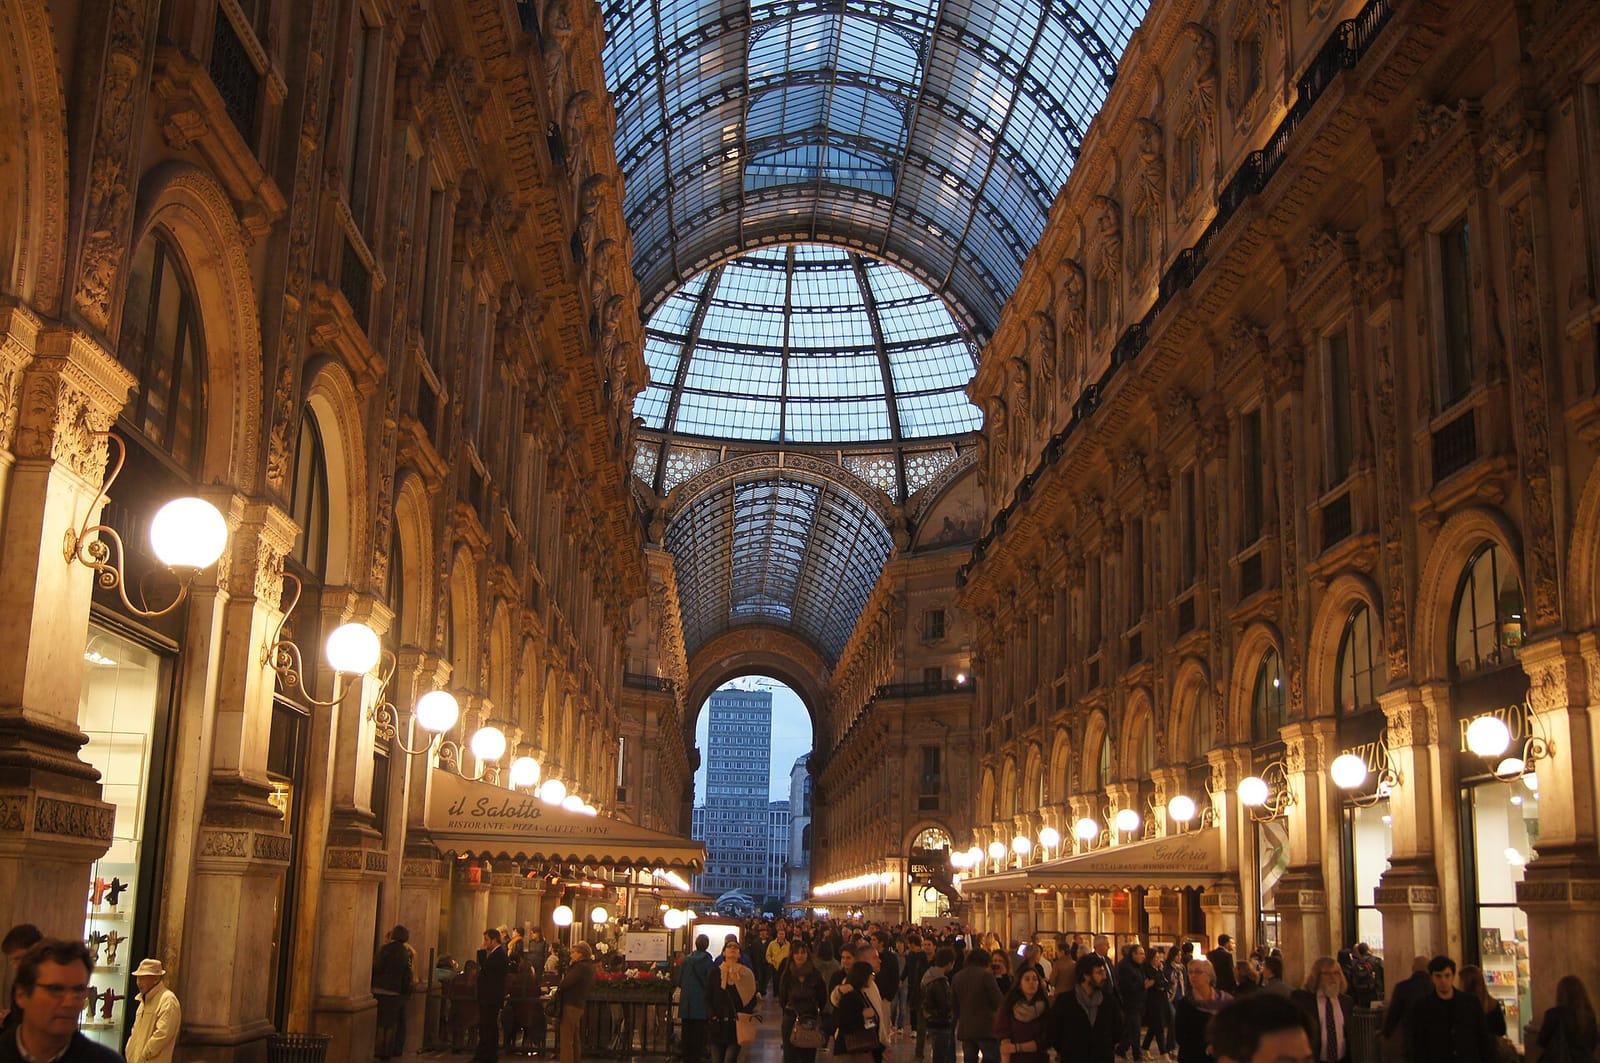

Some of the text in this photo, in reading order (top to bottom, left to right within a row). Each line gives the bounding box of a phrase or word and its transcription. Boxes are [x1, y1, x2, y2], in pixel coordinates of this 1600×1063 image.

[447, 796, 542, 819] il Salotto
[448, 820, 505, 831] RISTORANTE
[512, 823, 539, 832] PIZZA
[1152, 845, 1208, 862] Galleria
